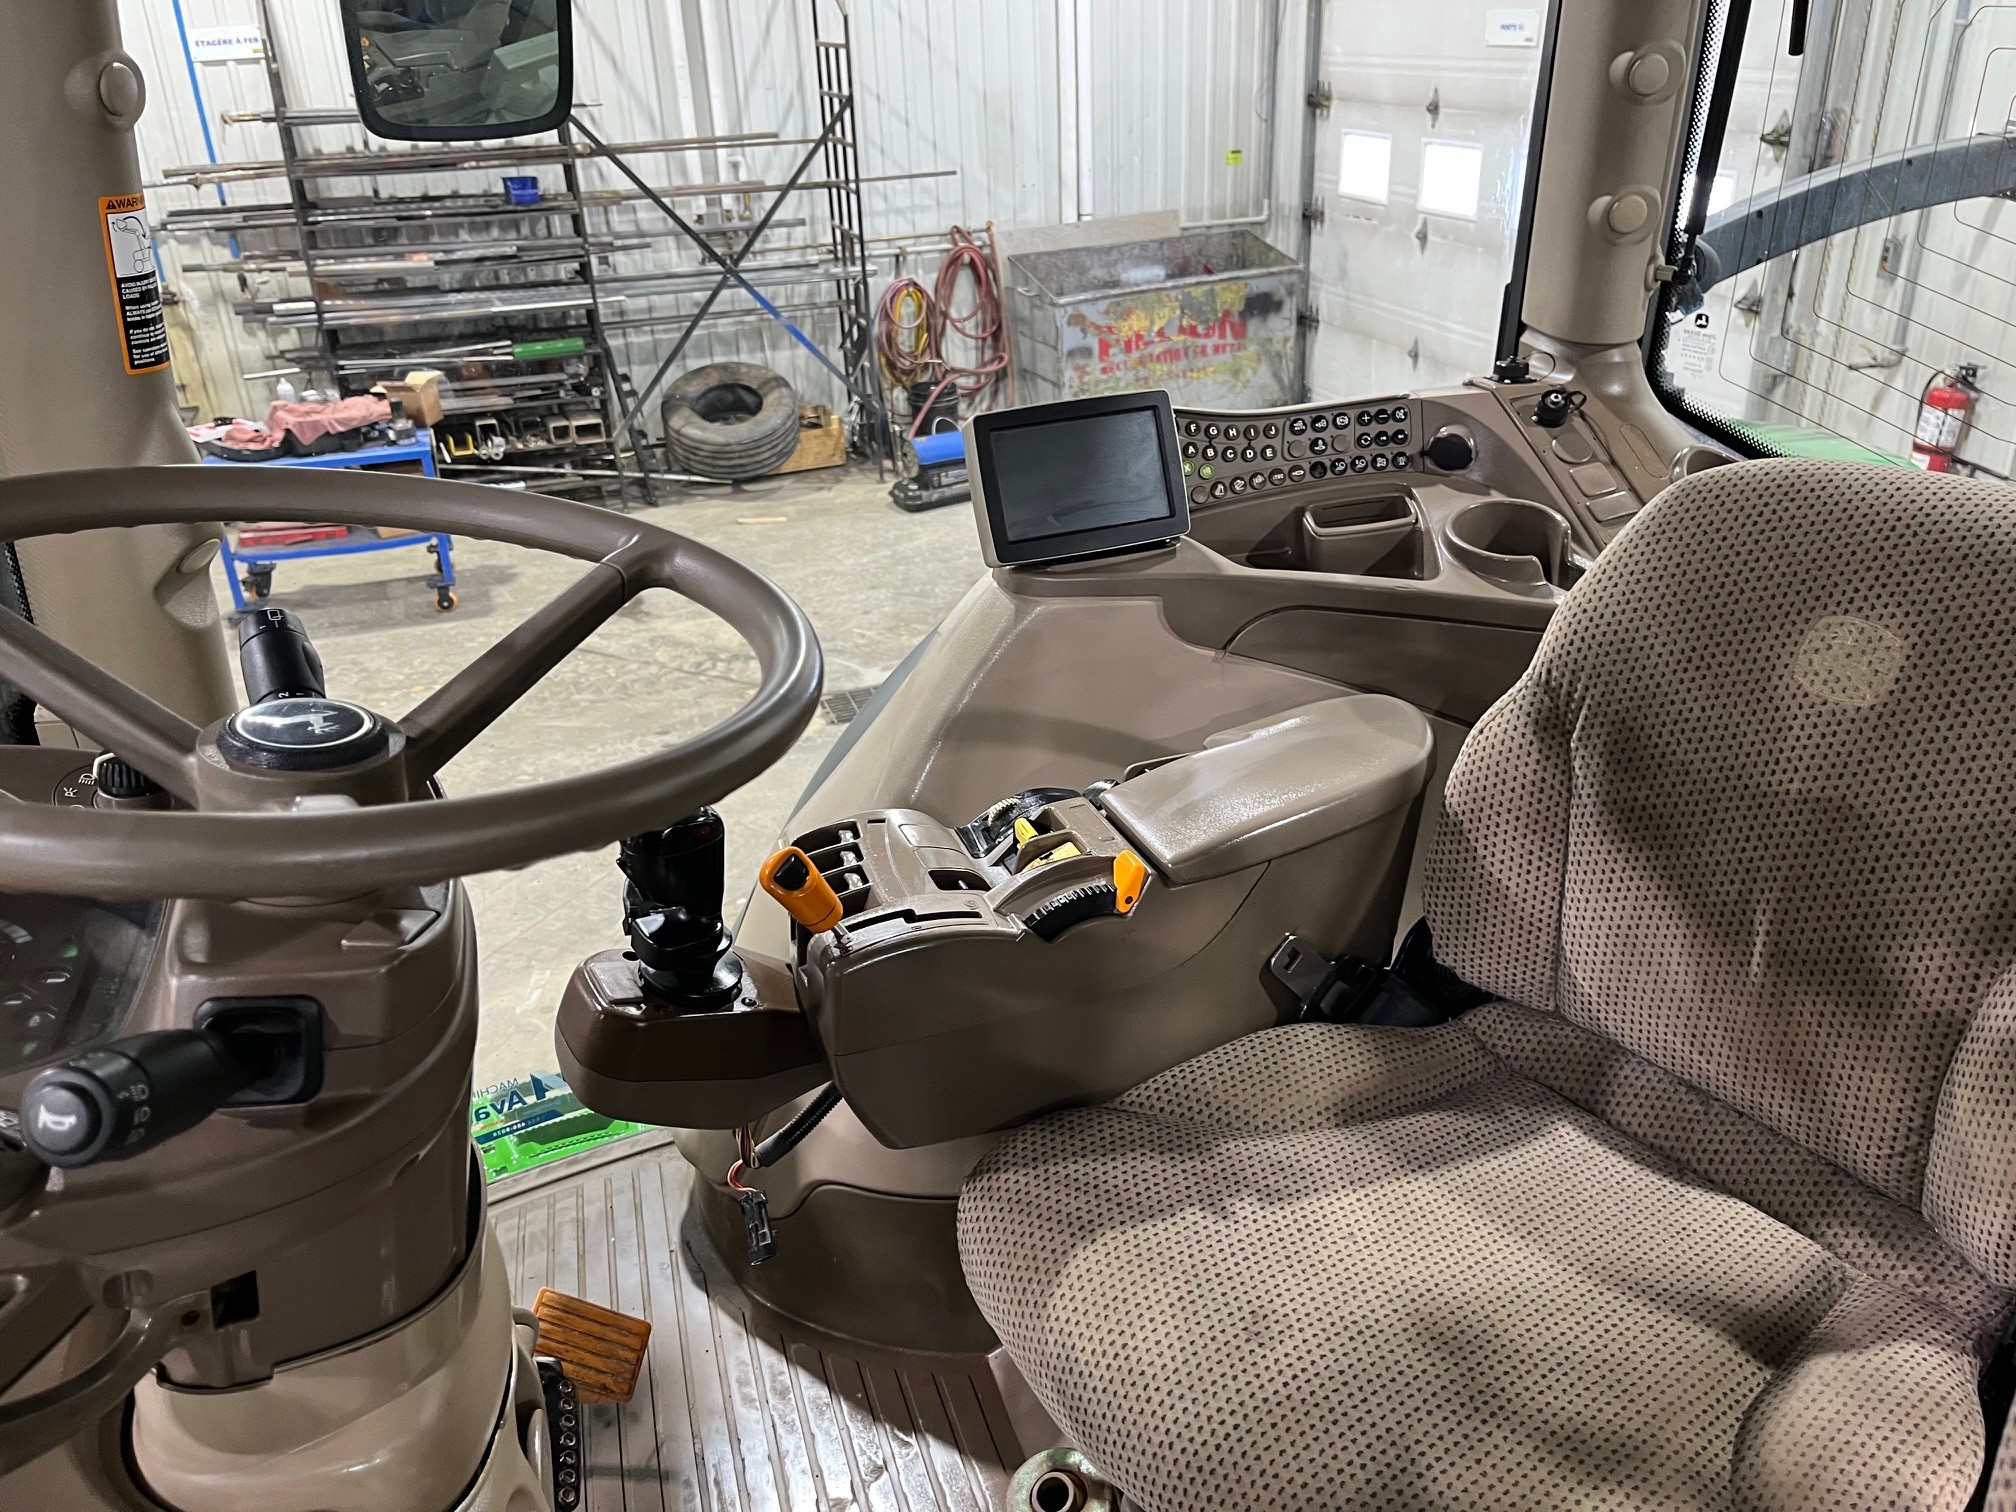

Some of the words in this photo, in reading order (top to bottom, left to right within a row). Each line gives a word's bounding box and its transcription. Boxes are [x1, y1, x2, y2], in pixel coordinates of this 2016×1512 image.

[122, 292, 140, 300] LOADS
[1190, 423, 1197, 433] F
[1209, 426, 1218, 436] G
[1228, 427, 1237, 438] H
[1250, 428, 1255, 437] I
[1269, 426, 1276, 435] J
[1188, 445, 1196, 455] A
[1206, 448, 1215, 457] B
[1226, 450, 1235, 459] C
[1246, 449, 1254, 458] D
[1265, 448, 1273, 457] E
